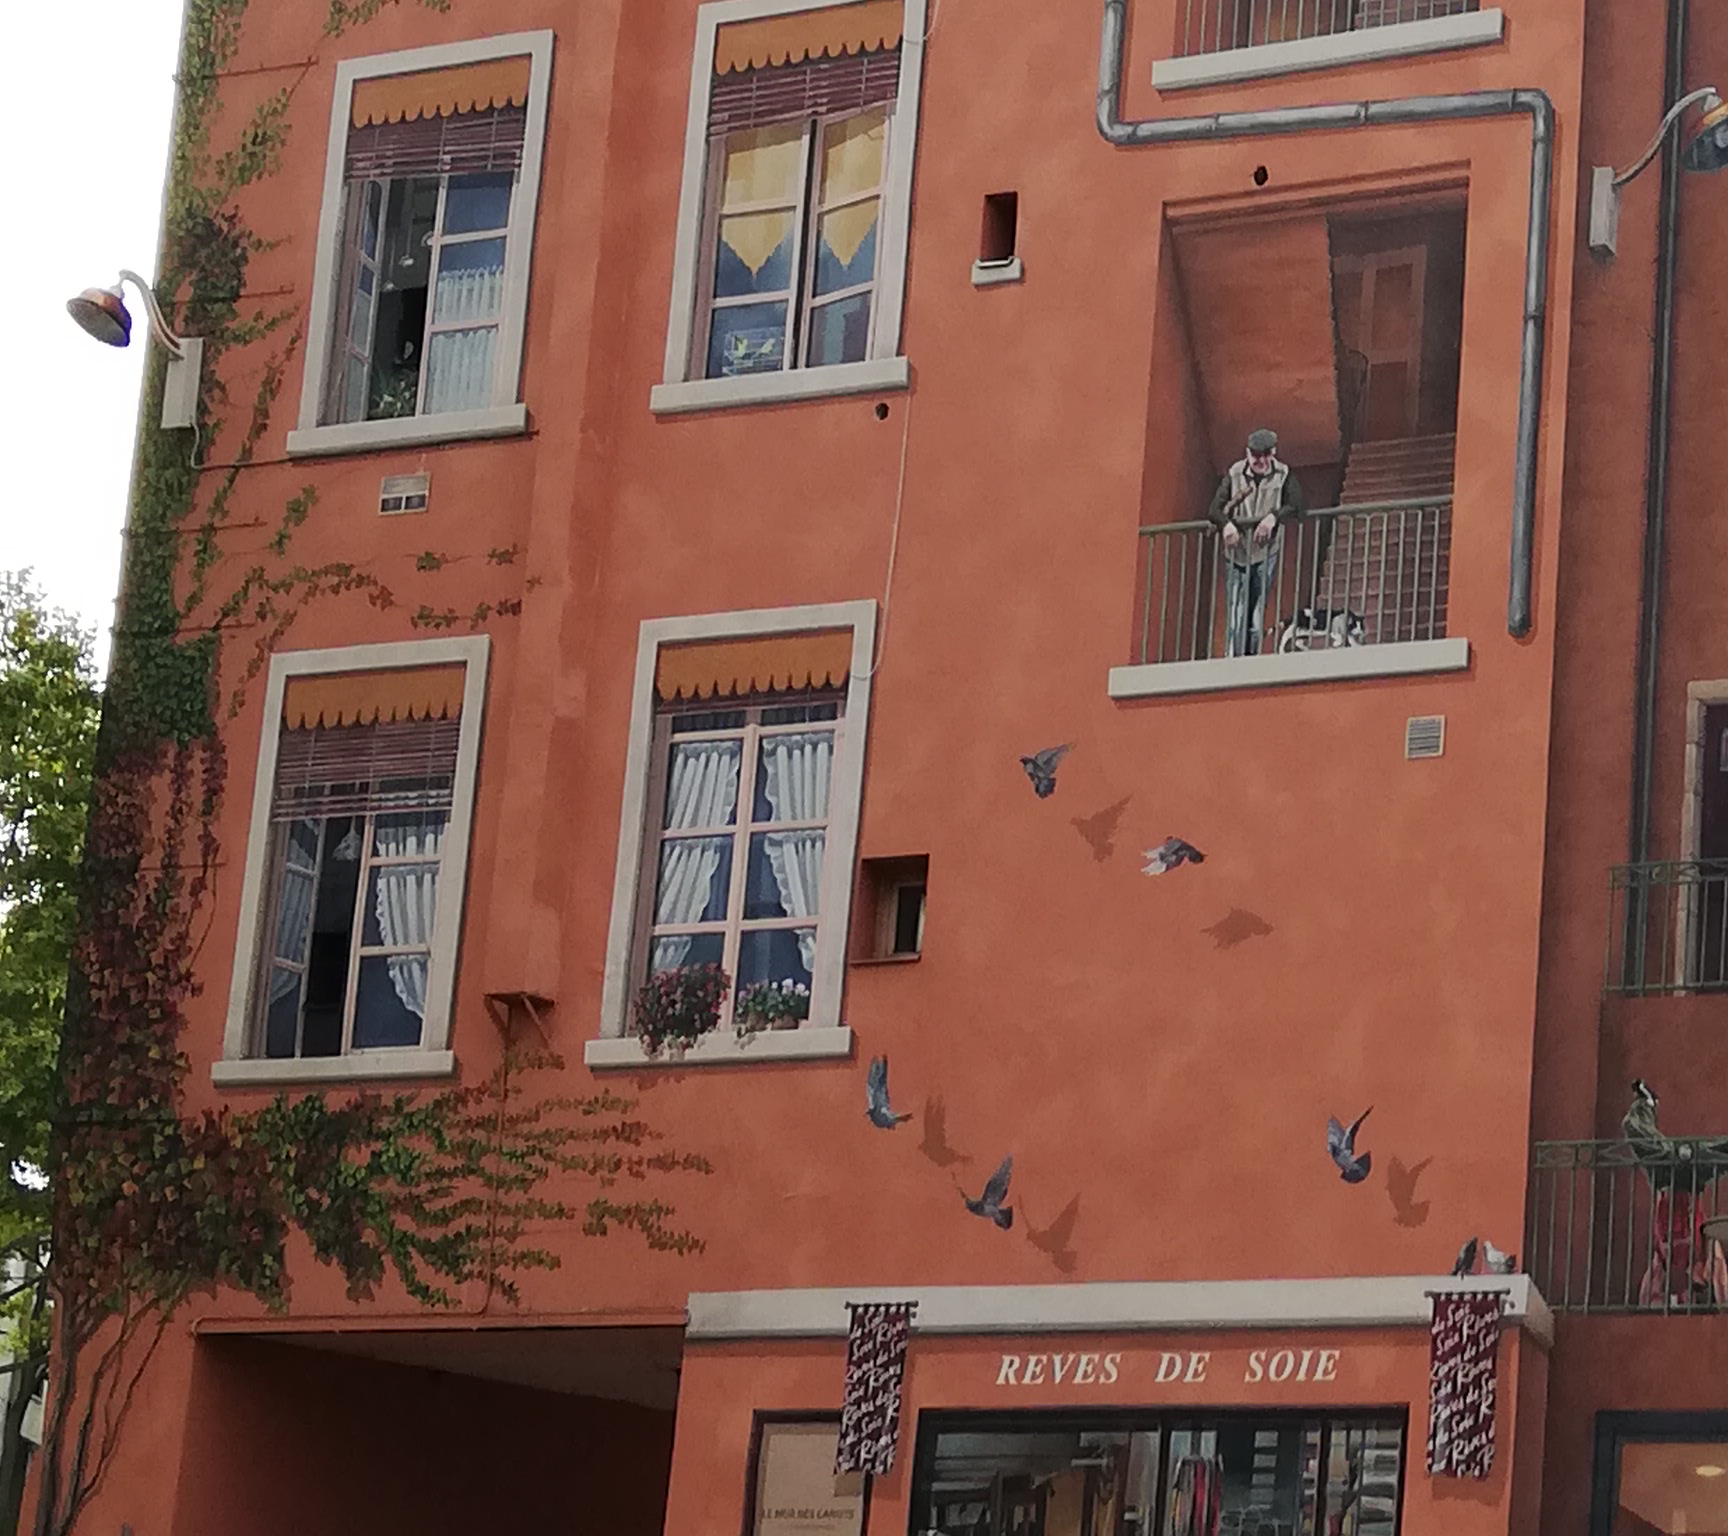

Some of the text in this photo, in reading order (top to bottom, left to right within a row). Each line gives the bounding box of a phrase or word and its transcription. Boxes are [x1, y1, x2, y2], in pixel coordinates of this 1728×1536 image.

[996, 1349, 1341, 1386] REVES DE SOIE
